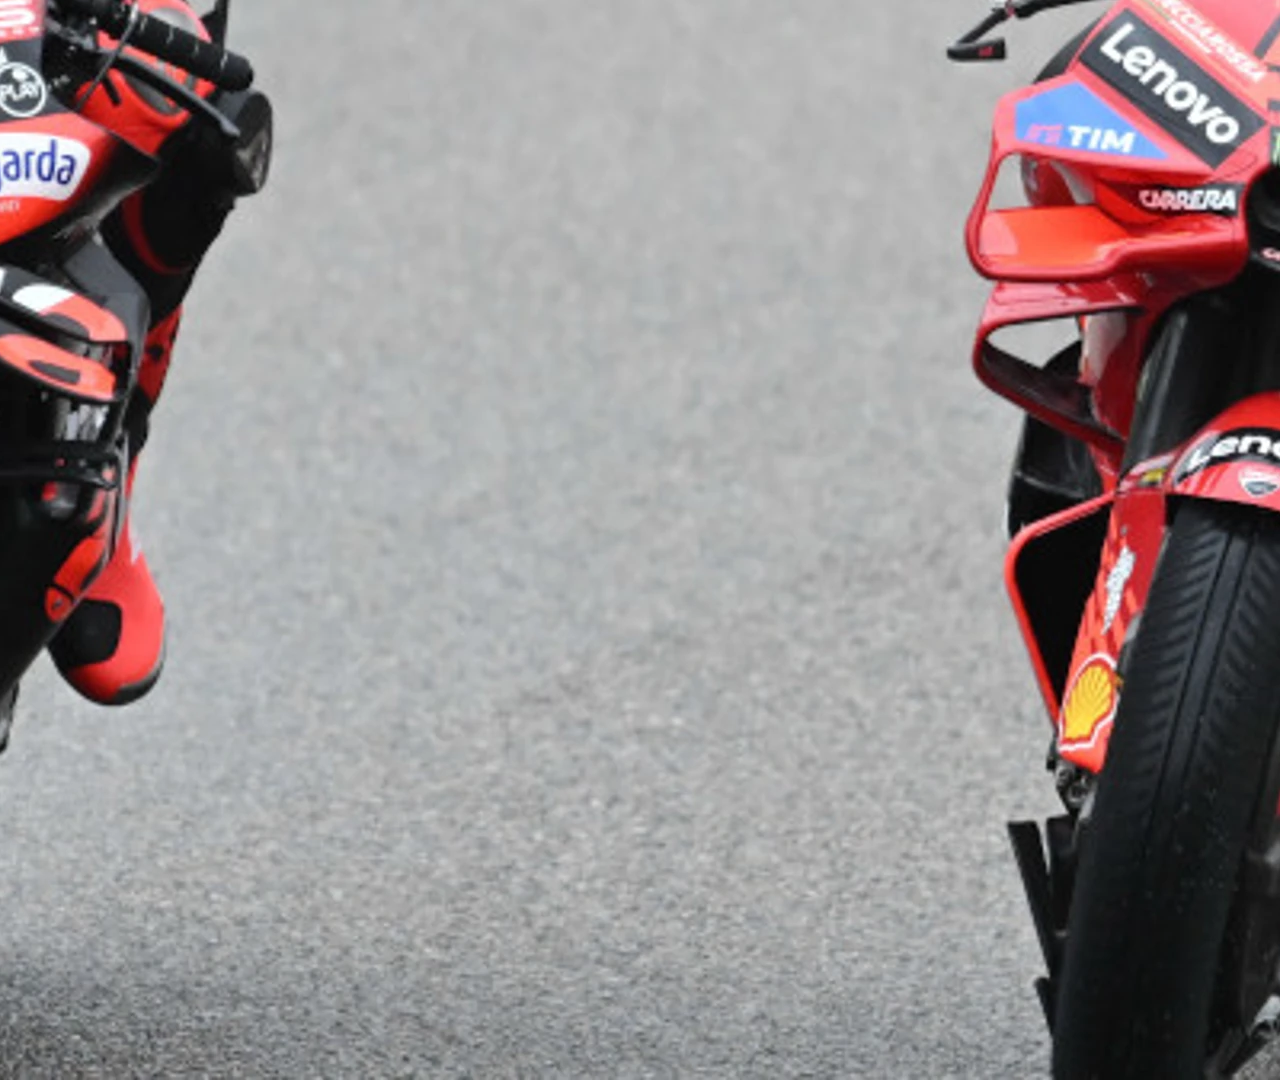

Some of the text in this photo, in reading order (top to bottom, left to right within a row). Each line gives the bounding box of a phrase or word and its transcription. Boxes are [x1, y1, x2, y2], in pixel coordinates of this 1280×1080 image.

[1100, 23, 1240, 144] Lenovo
[1067, 124, 1136, 154] TIM
[1138, 188, 1238, 211] CARRERA
